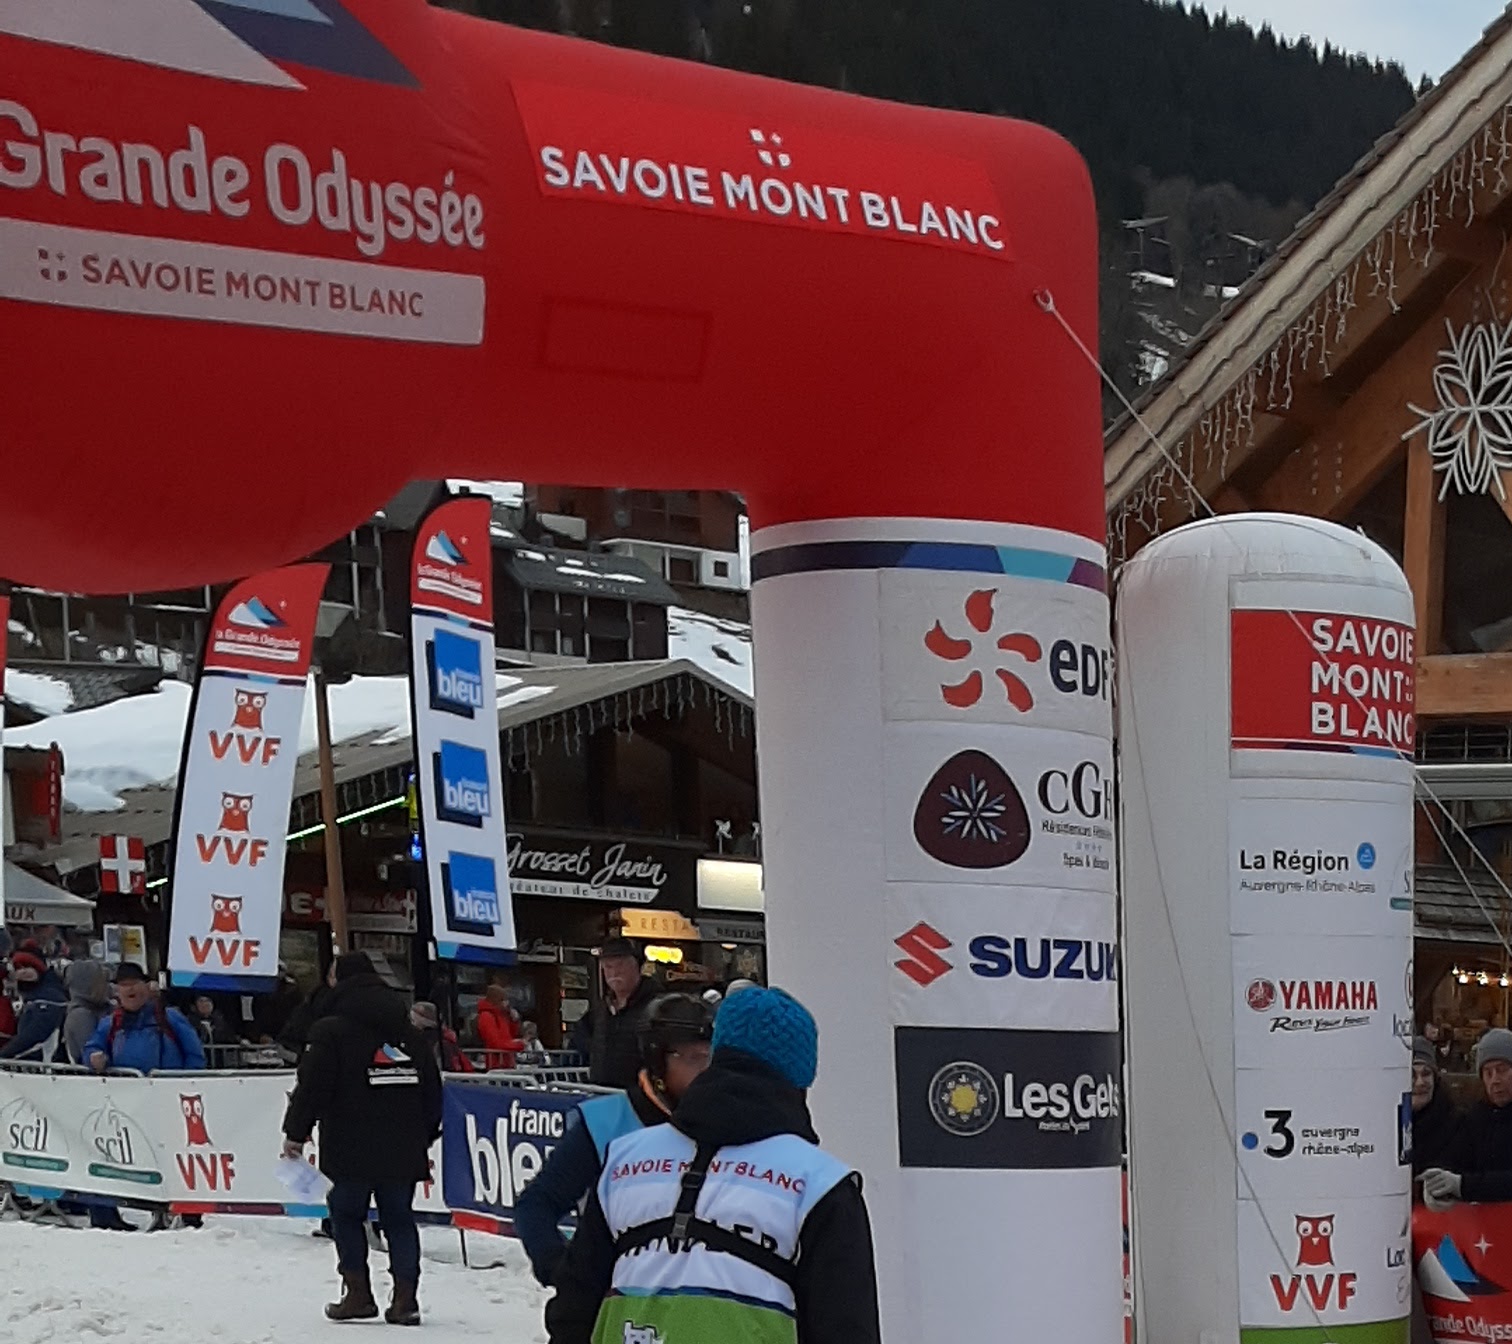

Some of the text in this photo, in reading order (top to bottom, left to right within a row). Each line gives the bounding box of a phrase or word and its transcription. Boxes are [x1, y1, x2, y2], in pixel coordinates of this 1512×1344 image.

[0, 102, 486, 257] Grande Odyssée
[540, 145, 1005, 250] SAVOIE MONT BLANC
[81, 254, 425, 318] SAVOIE MONT BLANC
[1312, 618, 1414, 665] SAVOIE
[437, 666, 483, 707] bleu
[1311, 660, 1405, 703] MONT
[1311, 701, 1414, 745] BLANC
[208, 729, 281, 766] VVF
[444, 778, 490, 813] bleu
[195, 832, 269, 867] VVF
[1240, 848, 1350, 875] La Région
[6, 907, 36, 921] UX
[453, 889, 499, 923] bleu
[188, 935, 261, 967] VVF
[968, 935, 1117, 982] SUZUK
[1279, 980, 1379, 1011] YAMAHA
[9, 1116, 49, 1151] scil
[510, 1099, 564, 1138] franc
[1263, 1109, 1295, 1158] 3
[94, 1126, 134, 1165] scil
[465, 1112, 557, 1208] ble
[175, 1152, 236, 1192] VVF
[612, 1158, 672, 1181] SAVOIE
[736, 1162, 807, 1194] BLANC
[1269, 1272, 1358, 1312] VVF
